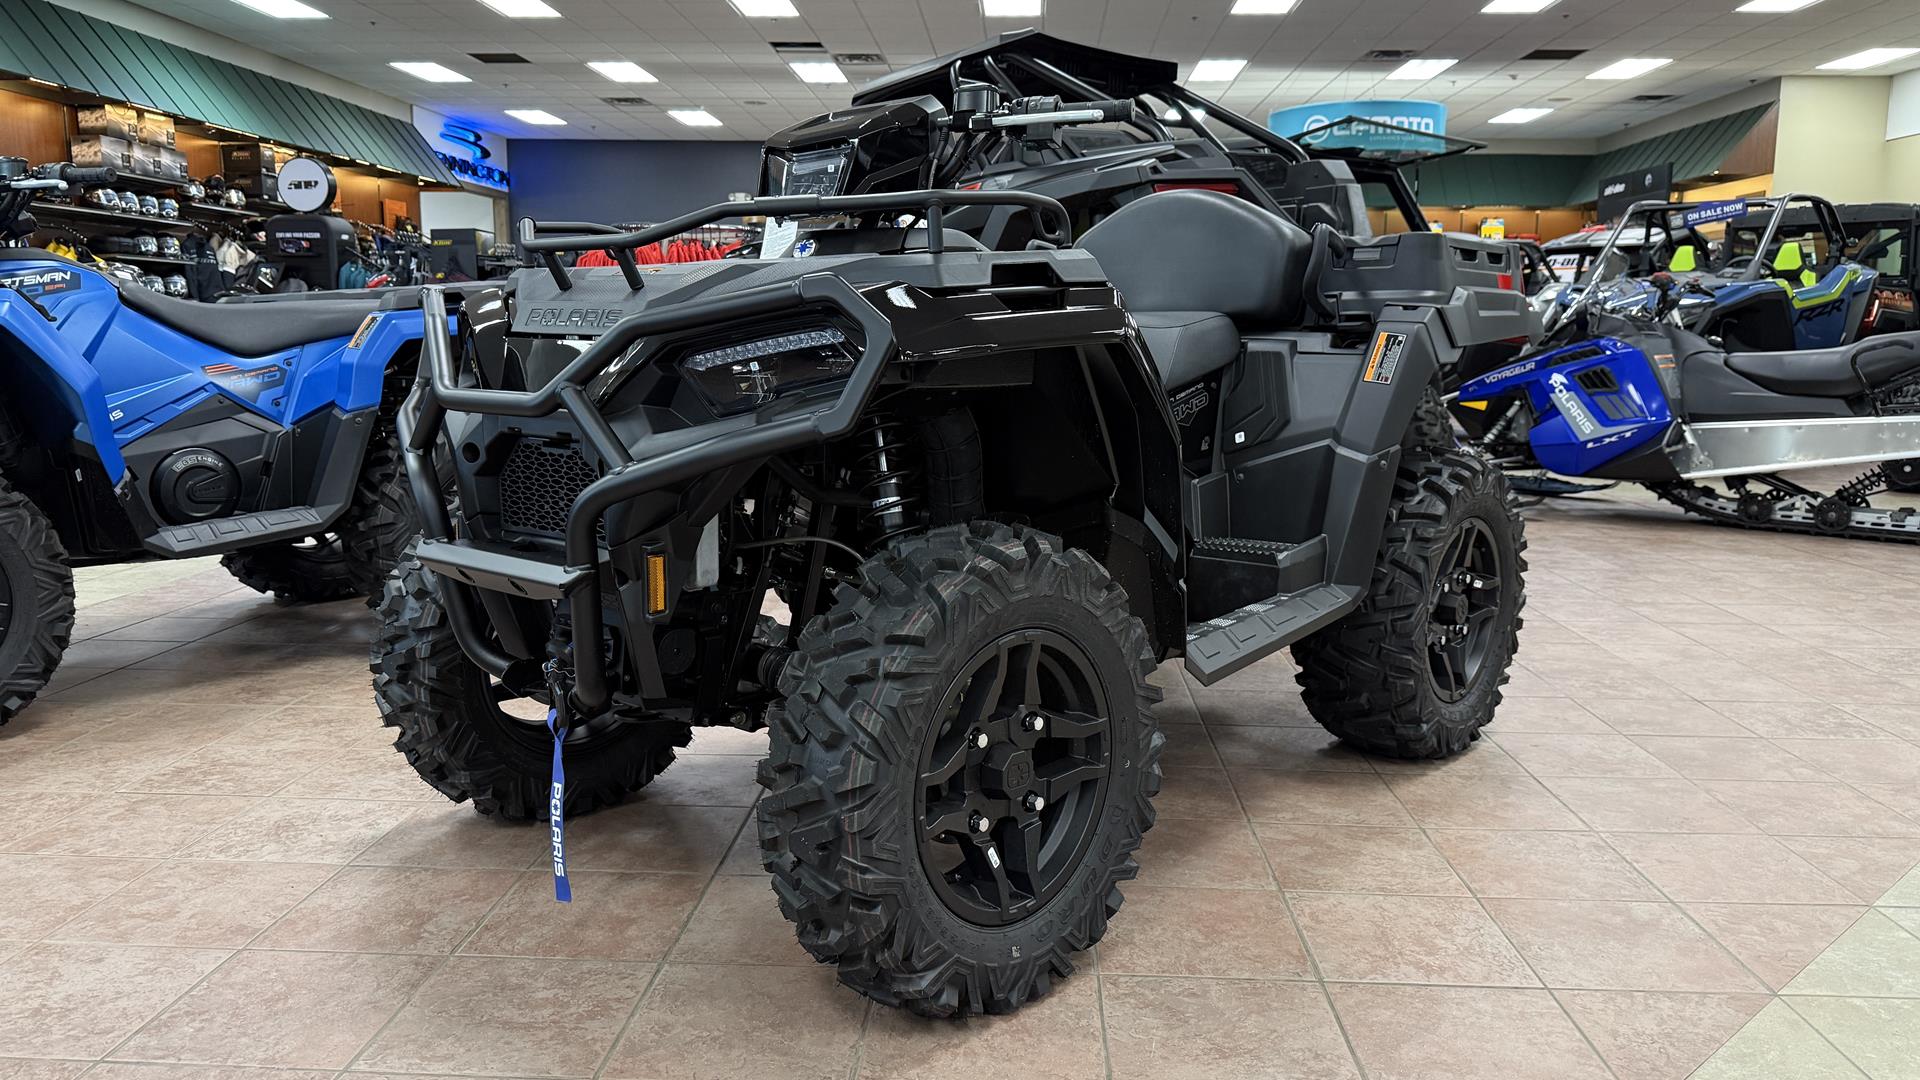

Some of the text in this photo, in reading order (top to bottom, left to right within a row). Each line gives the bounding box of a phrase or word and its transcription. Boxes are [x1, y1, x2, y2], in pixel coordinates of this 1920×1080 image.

[436, 151, 511, 187] NNINGTON
[1687, 211, 1699, 221] ON
[1699, 207, 1722, 218] SALE
[1723, 203, 1743, 213] NOW
[0, 271, 71, 288] RTSMAN
[525, 307, 624, 328] POLARIS
[1484, 361, 1536, 384] VOYAGEUR
[1549, 376, 1594, 435] POLARIS
[1586, 429, 1639, 449] LXT
[551, 782, 565, 877] POLARIS
